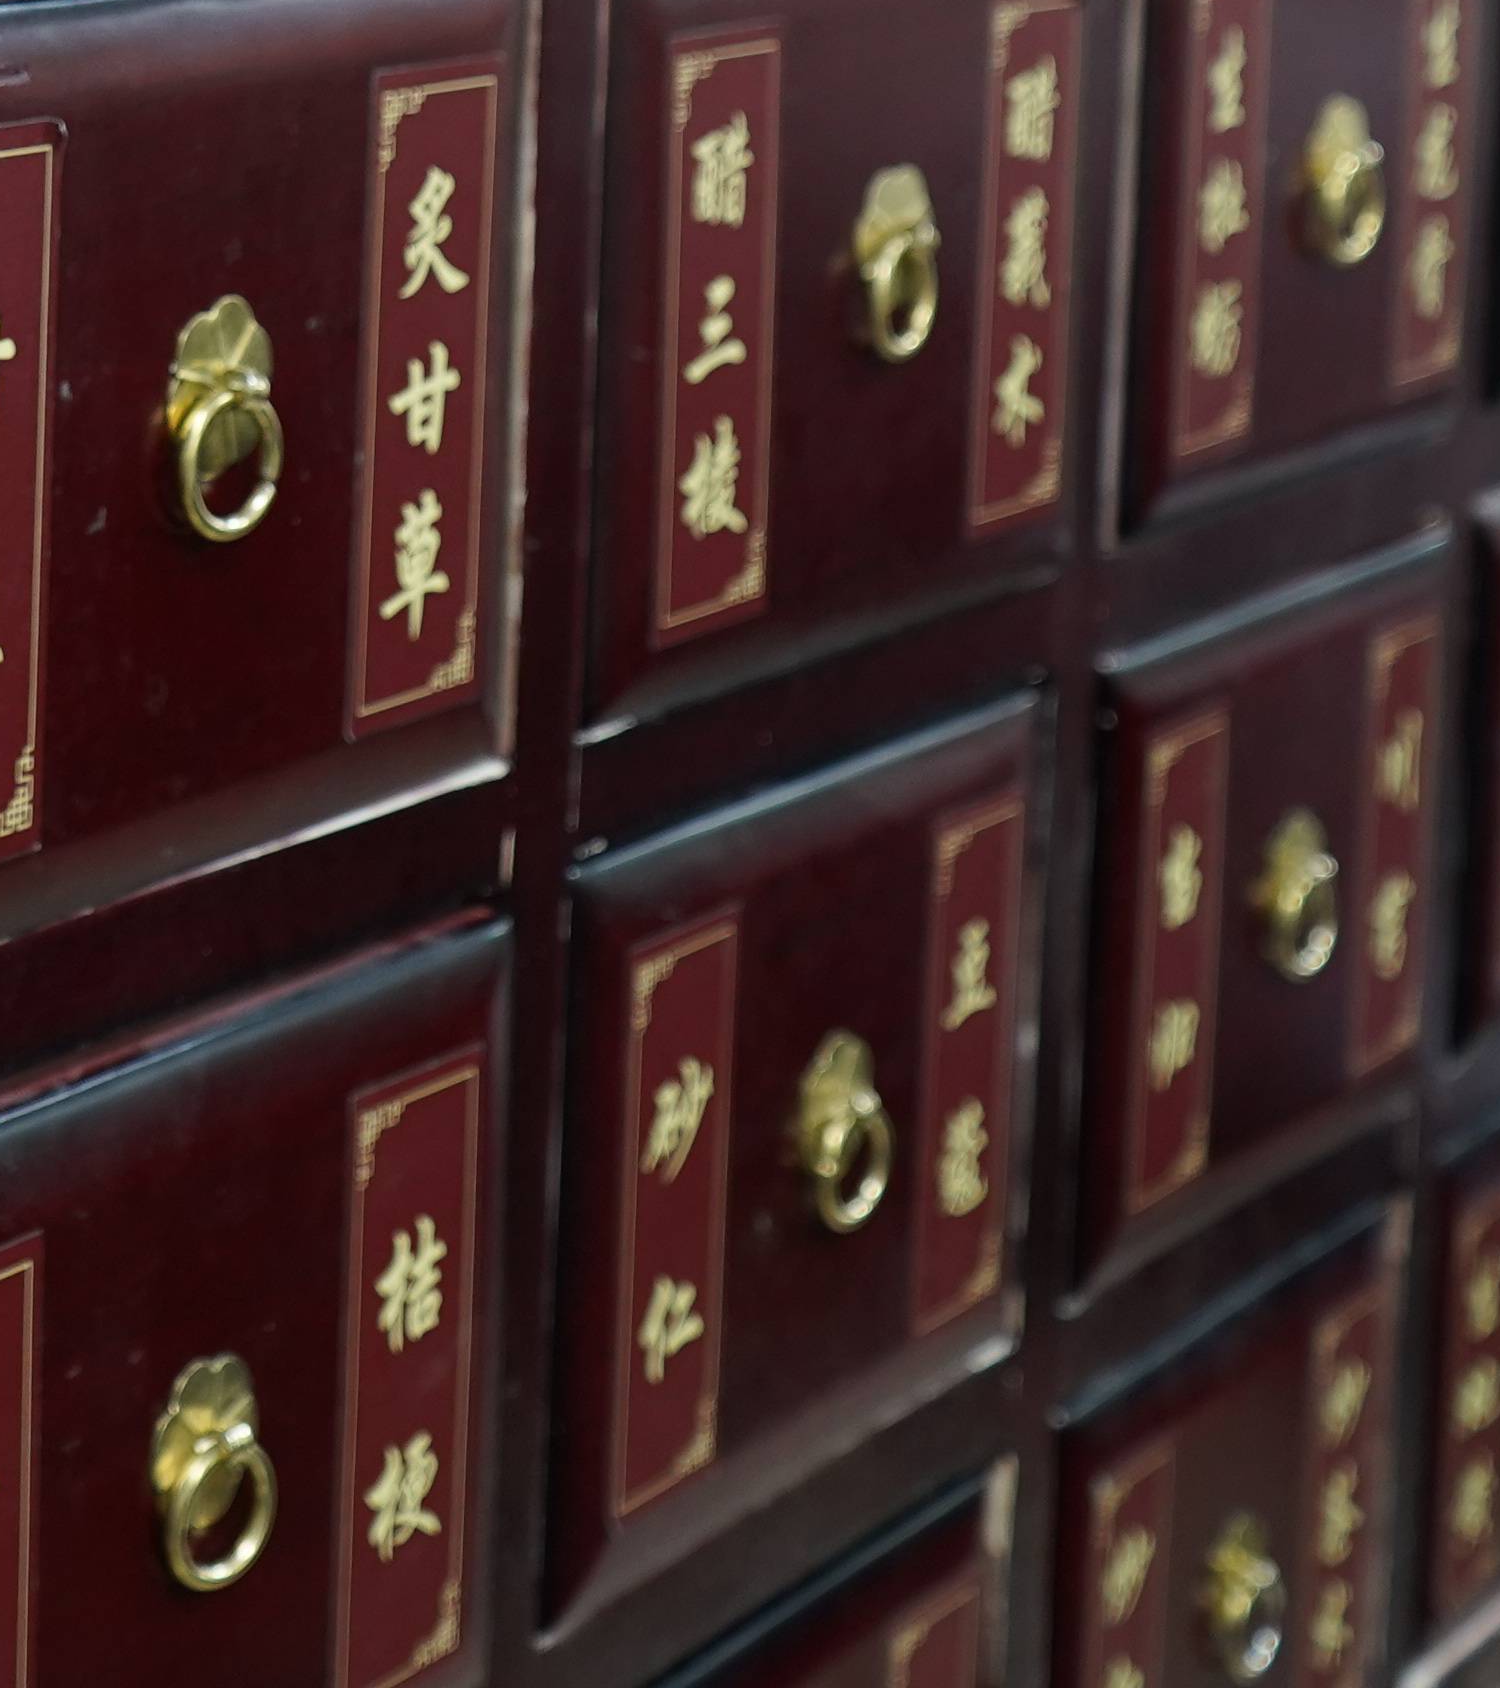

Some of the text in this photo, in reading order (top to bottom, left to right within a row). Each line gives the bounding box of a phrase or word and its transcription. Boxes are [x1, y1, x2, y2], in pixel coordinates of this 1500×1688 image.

[380, 164, 470, 642] 炙甘草
[679, 109, 755, 540] 醋三棱
[364, 1214, 448, 1562] 桔梗
[639, 1056, 716, 1383] 砂仁
